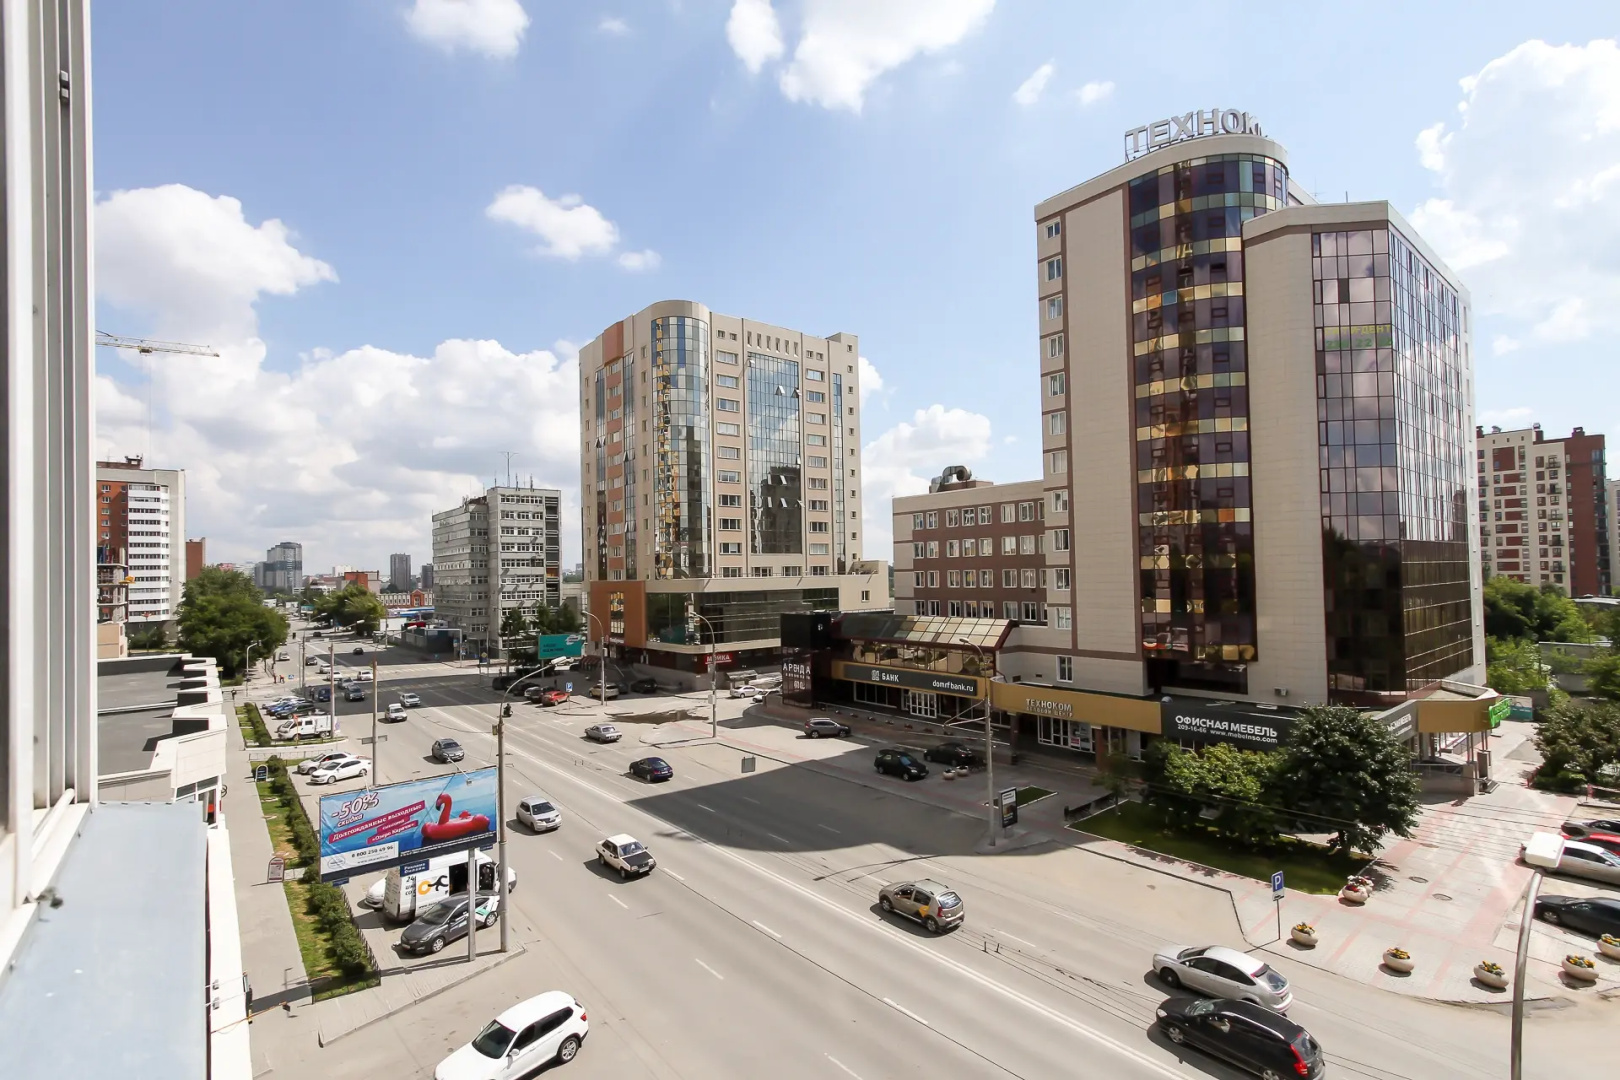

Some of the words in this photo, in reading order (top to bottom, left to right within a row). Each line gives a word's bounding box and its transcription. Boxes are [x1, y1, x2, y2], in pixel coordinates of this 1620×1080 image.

[782, 662, 811, 675] АРЕНДА
[881, 672, 899, 682] БАНК
[932, 680, 974, 692] domrfbank.ru
[1025, 698, 1072, 712] ТЕХНОКОМ
[1175, 715, 1229, 730] ОФИСНАЯ
[1230, 722, 1278, 737] МЕБЕЛЬ
[331, 792, 379, 819] -50%
[332, 817, 387, 841] Долгожданные
[387, 804, 422, 820] выходные
[337, 813, 364, 827] скидка
[1274, 875, 1281, 890] P
